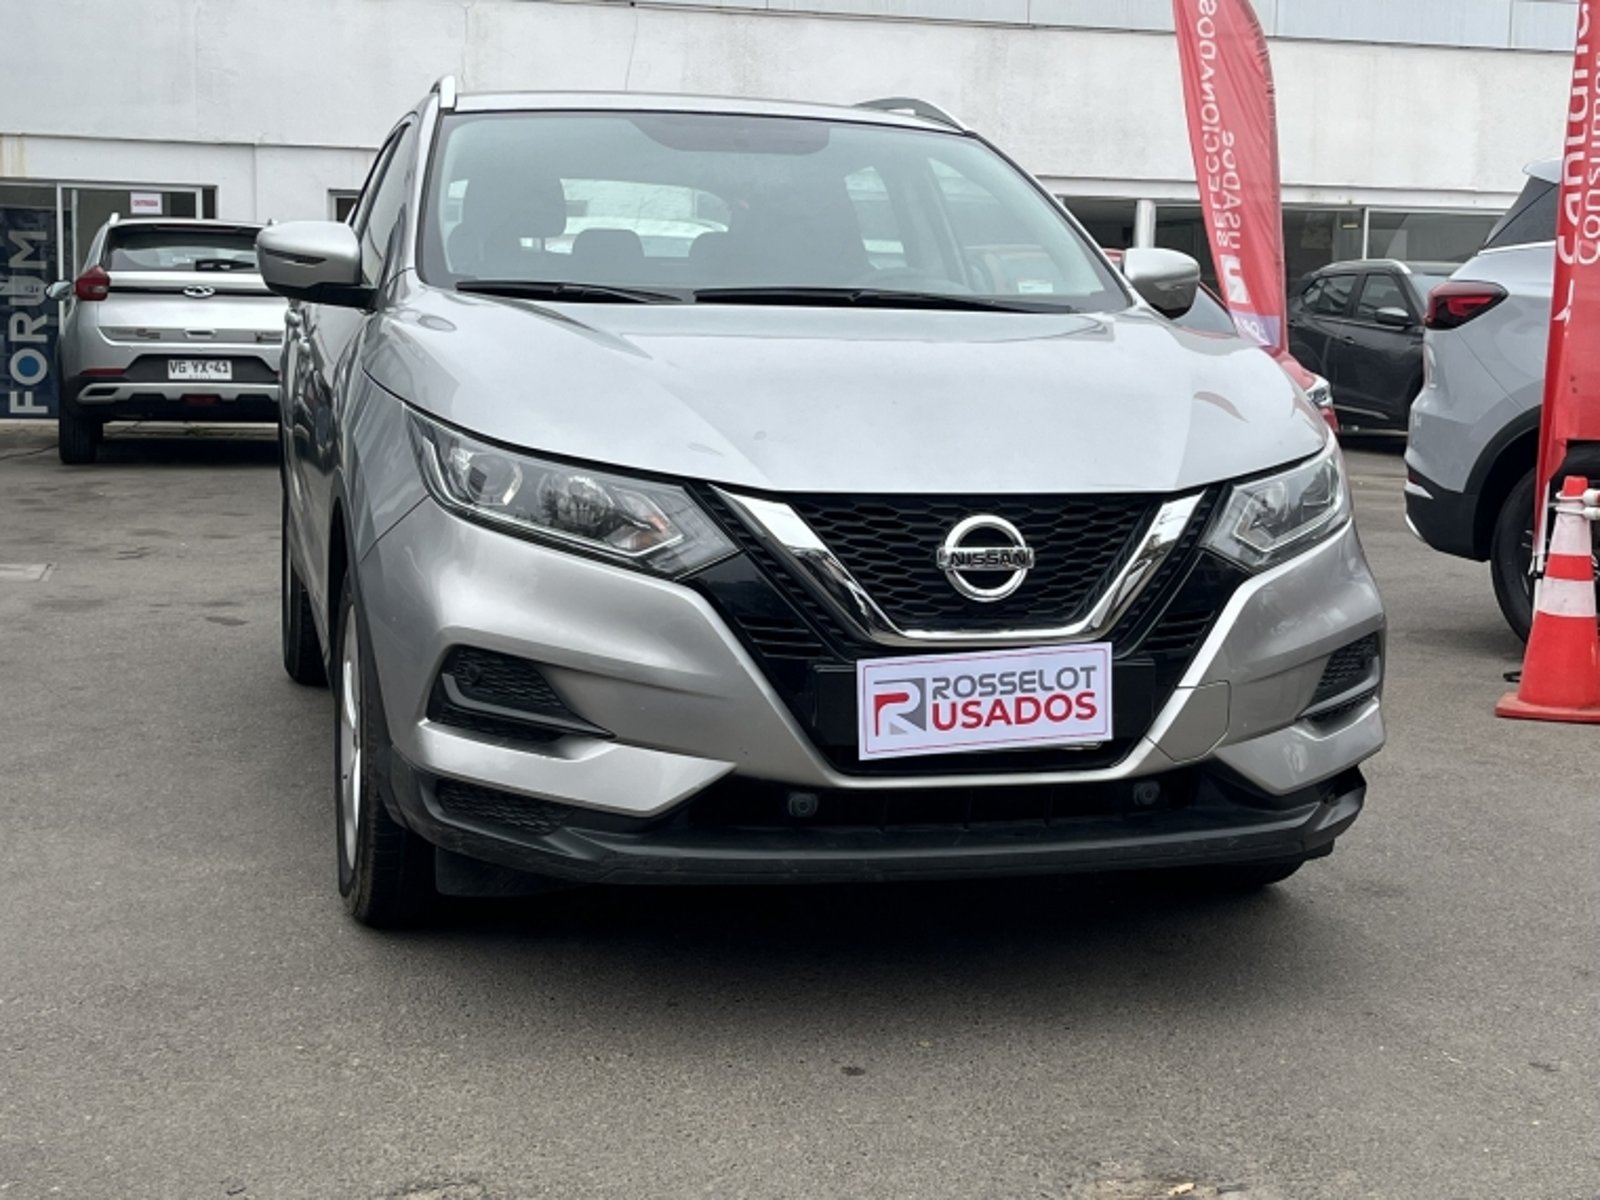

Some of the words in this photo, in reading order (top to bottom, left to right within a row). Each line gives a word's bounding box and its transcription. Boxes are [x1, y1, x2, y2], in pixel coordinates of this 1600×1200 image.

[8, 230, 48, 414] FORUM
[949, 551, 1028, 566] NISSAN
[932, 665, 1097, 700] ROSSELOT
[932, 691, 1098, 731] USADOS
